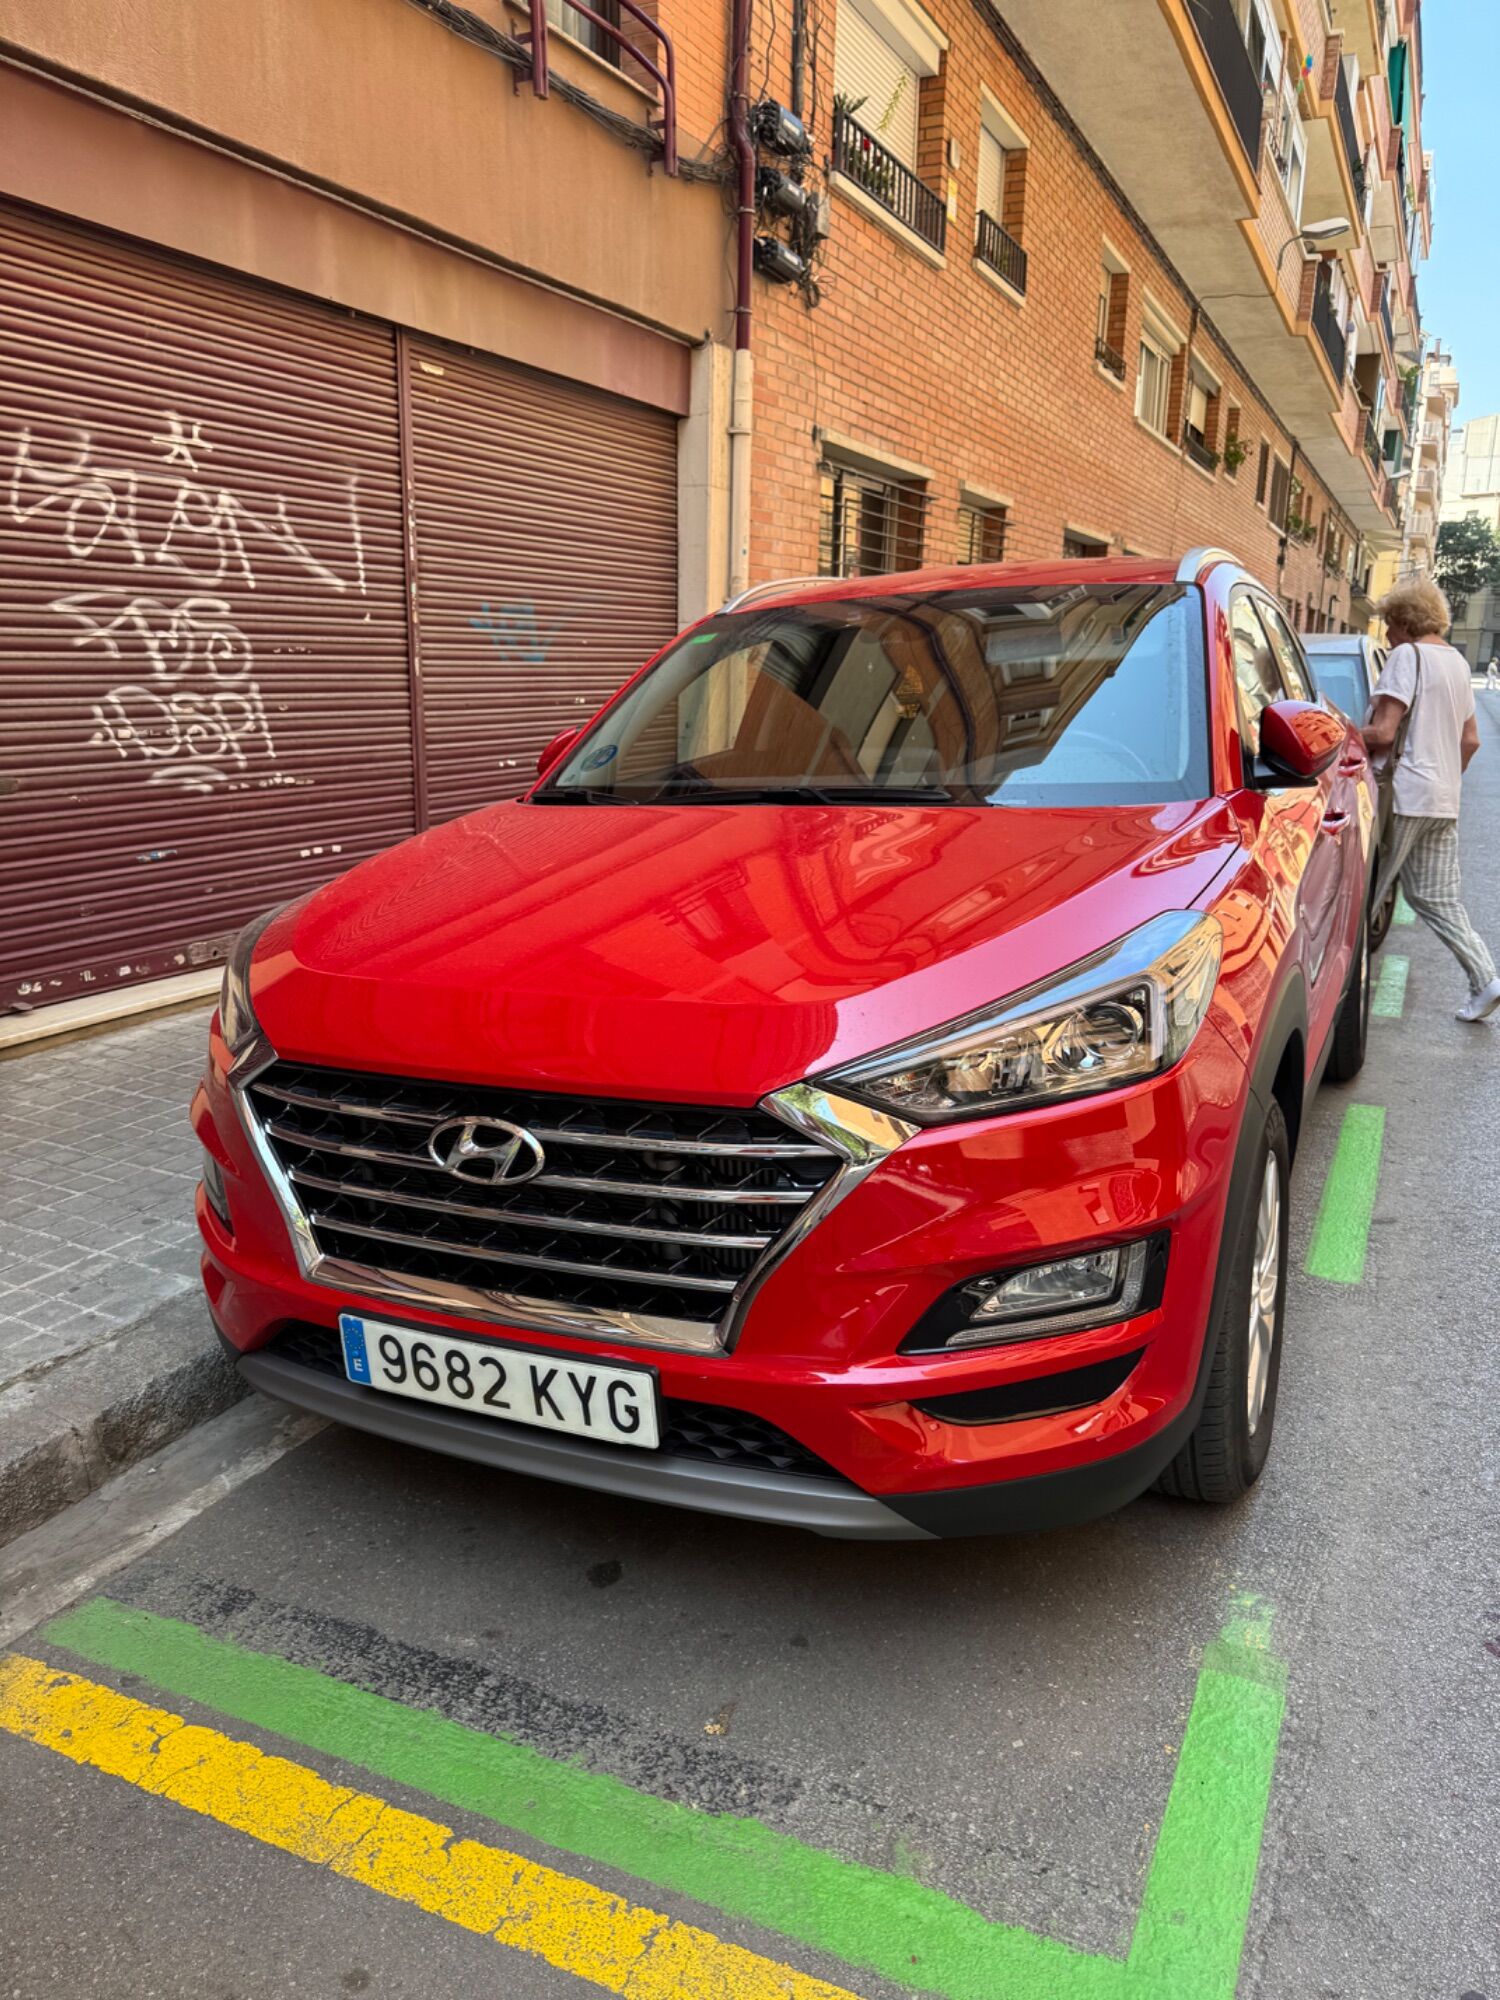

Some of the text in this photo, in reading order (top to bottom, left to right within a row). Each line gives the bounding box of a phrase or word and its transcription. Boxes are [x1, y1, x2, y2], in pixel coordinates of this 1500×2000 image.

[353, 1358, 364, 1372] E
[378, 1334, 641, 1434] 9682 KYG
